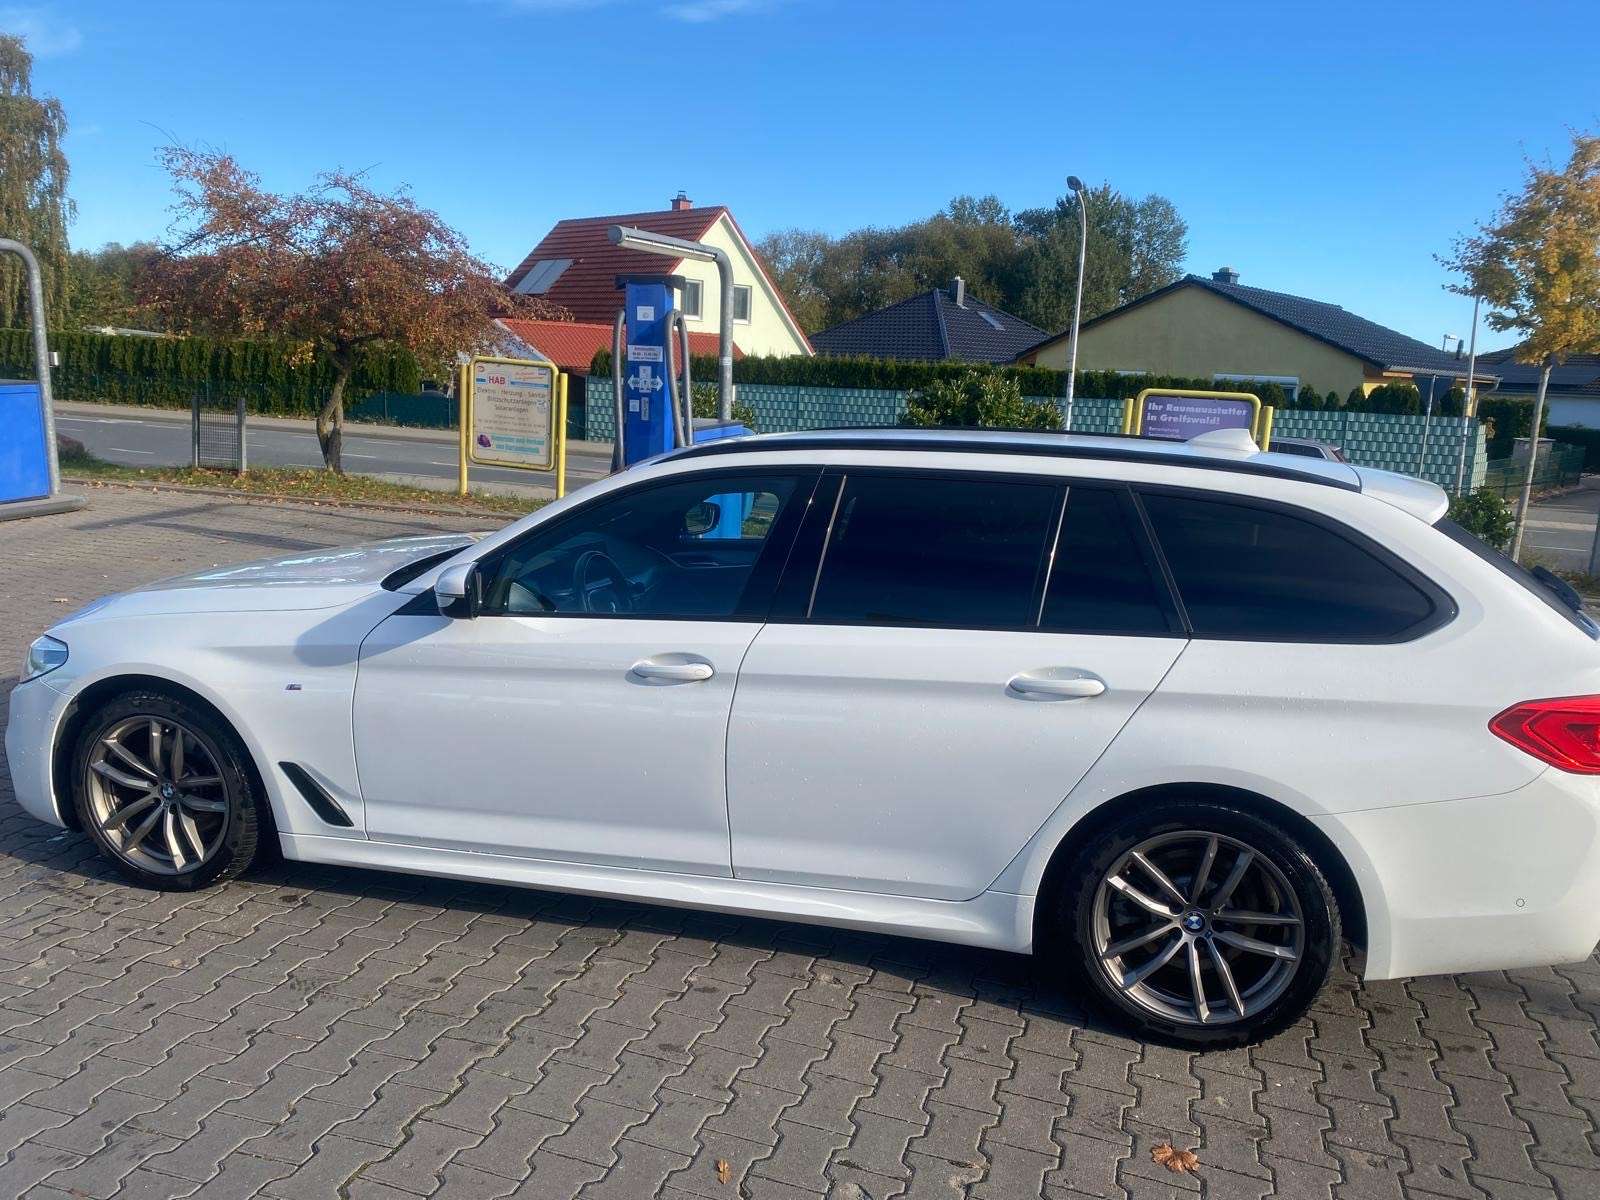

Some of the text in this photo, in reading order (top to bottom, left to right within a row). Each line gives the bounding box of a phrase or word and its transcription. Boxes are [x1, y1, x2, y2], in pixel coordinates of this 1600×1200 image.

[488, 375, 506, 385] HAB
[1148, 402, 1248, 416] Ihr Raumausstatter
[1147, 412, 1220, 425] in Greifswald!
